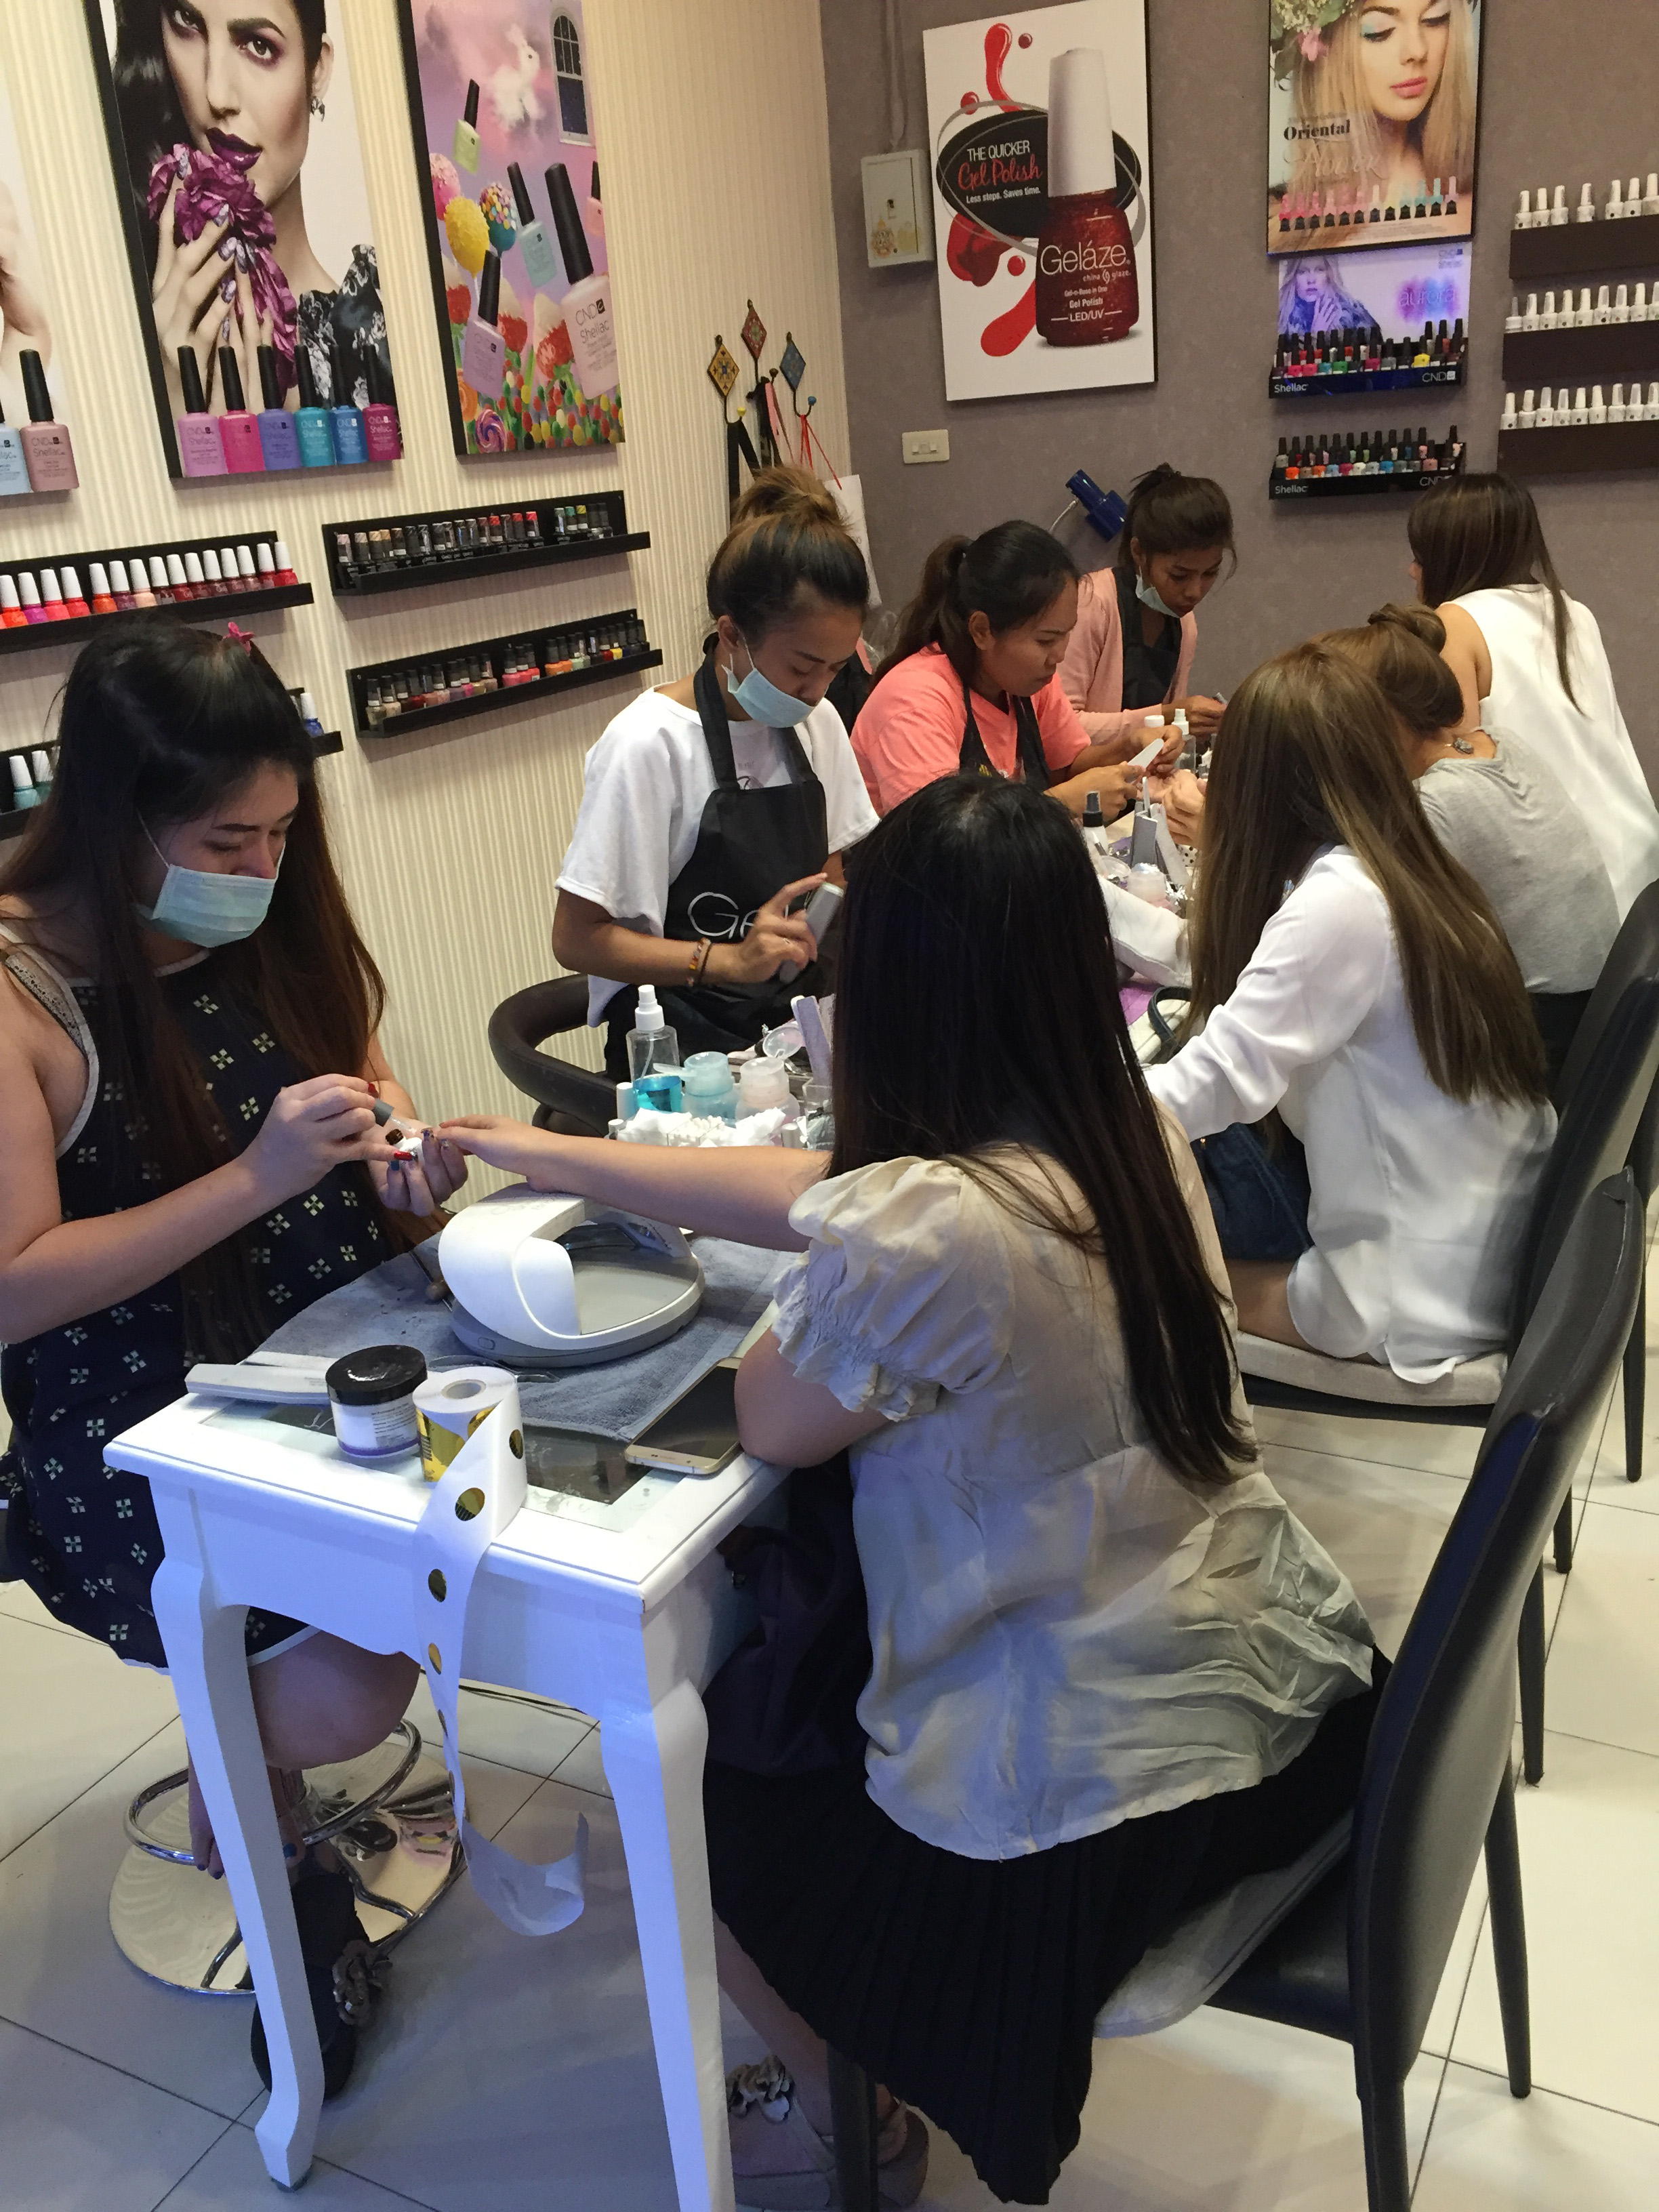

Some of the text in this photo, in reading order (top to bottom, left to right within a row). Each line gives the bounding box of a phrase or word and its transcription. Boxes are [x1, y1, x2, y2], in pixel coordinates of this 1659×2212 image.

[1284, 119, 1350, 140] Oriental
[967, 140, 1030, 162] THE QUICKER
[958, 153, 1043, 190] Gel Polish
[966, 195, 981, 204] Less
[983, 192, 1002, 201] steps.
[1003, 188, 1023, 199] Saves
[1069, 297, 1103, 309] Gel Polish
[1069, 308, 1105, 323] LED/UV
[580, 320, 609, 344] Shellac
[1274, 383, 1307, 393] Shellac
[1275, 485, 1307, 494] Shellac
